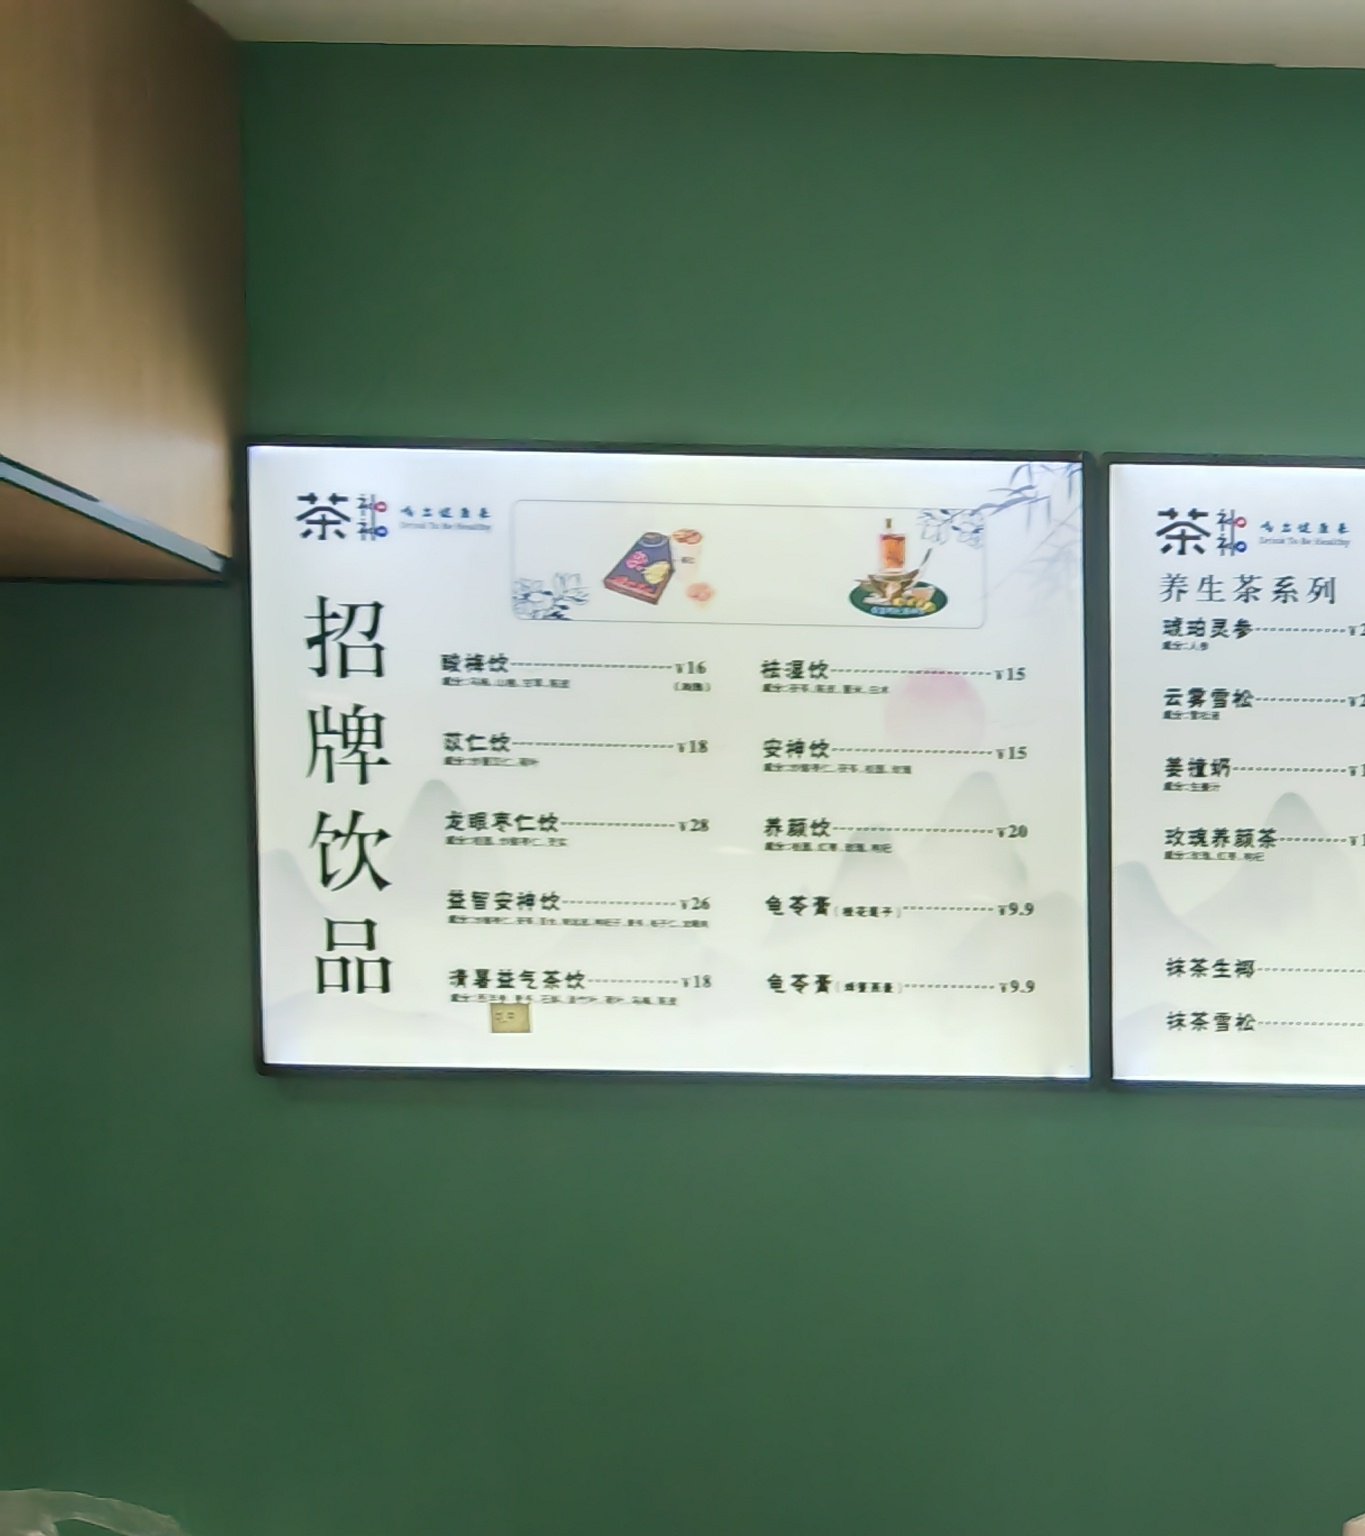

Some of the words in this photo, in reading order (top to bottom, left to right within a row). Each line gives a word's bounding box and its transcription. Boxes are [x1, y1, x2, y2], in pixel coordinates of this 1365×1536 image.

[1159, 573, 1336, 604] 养生茶系列
[1162, 617, 1252, 639] 琥珀灵参
[1163, 687, 1254, 708] 云雾雪松
[763, 738, 830, 759] 安神饮
[304, 595, 392, 995] 招牌饮品
[445, 811, 559, 832] 龙眼枣仁饮
[763, 817, 831, 838] 养颜饮
[1164, 827, 1277, 848] 玫瑰养颜茶
[447, 889, 561, 911] 益智安神饮
[765, 895, 831, 917] 龟苓膏
[1165, 957, 1256, 978] 抹茶生椰
[449, 968, 585, 990] 清暑益气茶饮
[766, 973, 833, 994] 龟苓膏
[1166, 1011, 1256, 1032] 抹茶雪松
